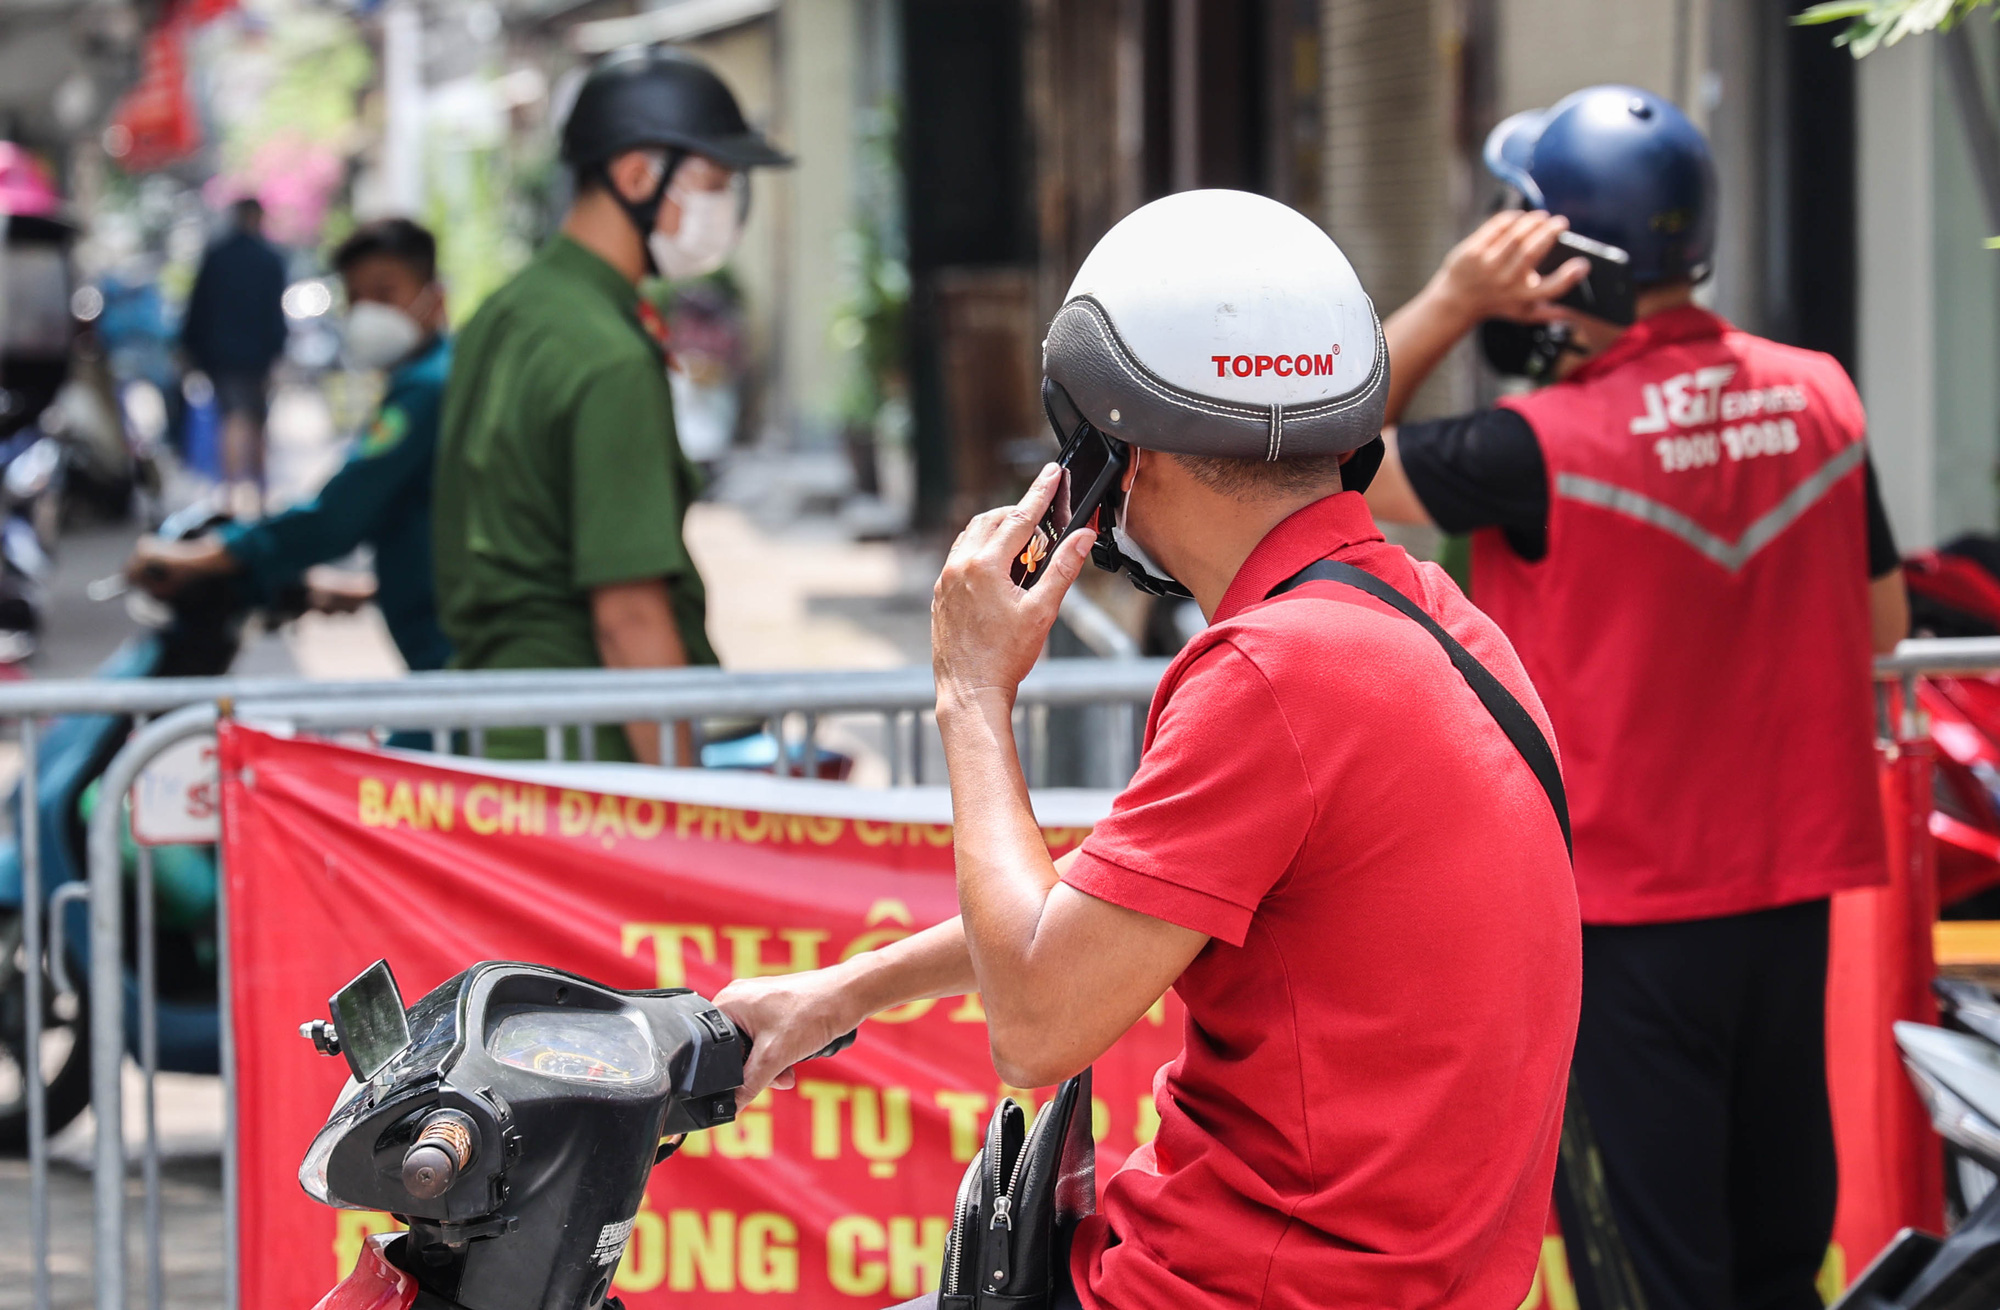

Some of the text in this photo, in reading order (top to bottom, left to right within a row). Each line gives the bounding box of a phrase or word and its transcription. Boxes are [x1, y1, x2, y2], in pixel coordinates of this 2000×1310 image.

[358, 778, 453, 831] BAN
[557, 788, 667, 849] ĐẠO
[800, 1081, 913, 1177] TỤ
